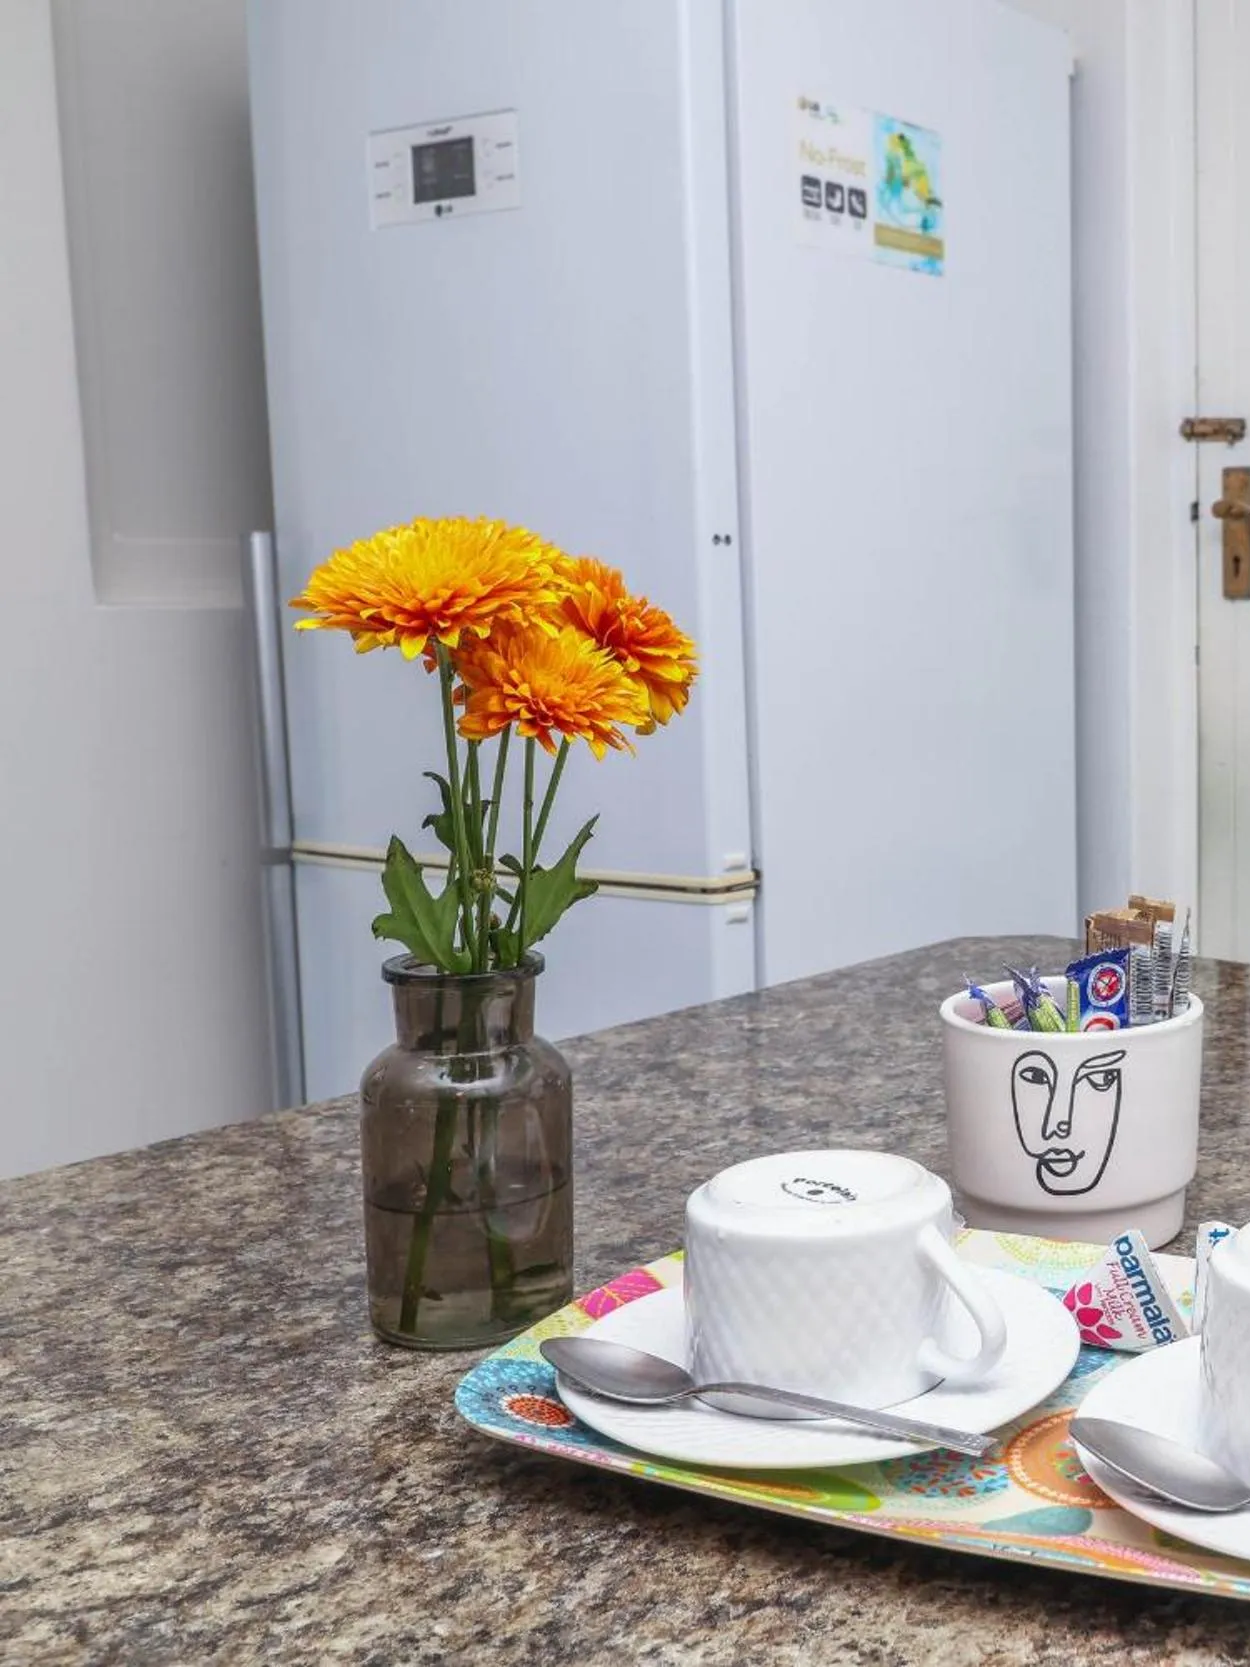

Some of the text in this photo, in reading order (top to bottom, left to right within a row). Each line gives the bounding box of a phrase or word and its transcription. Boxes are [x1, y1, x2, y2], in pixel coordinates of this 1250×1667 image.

[1102, 1288, 1124, 1321] Milk
[1106, 1261, 1149, 1340] Full Cream
